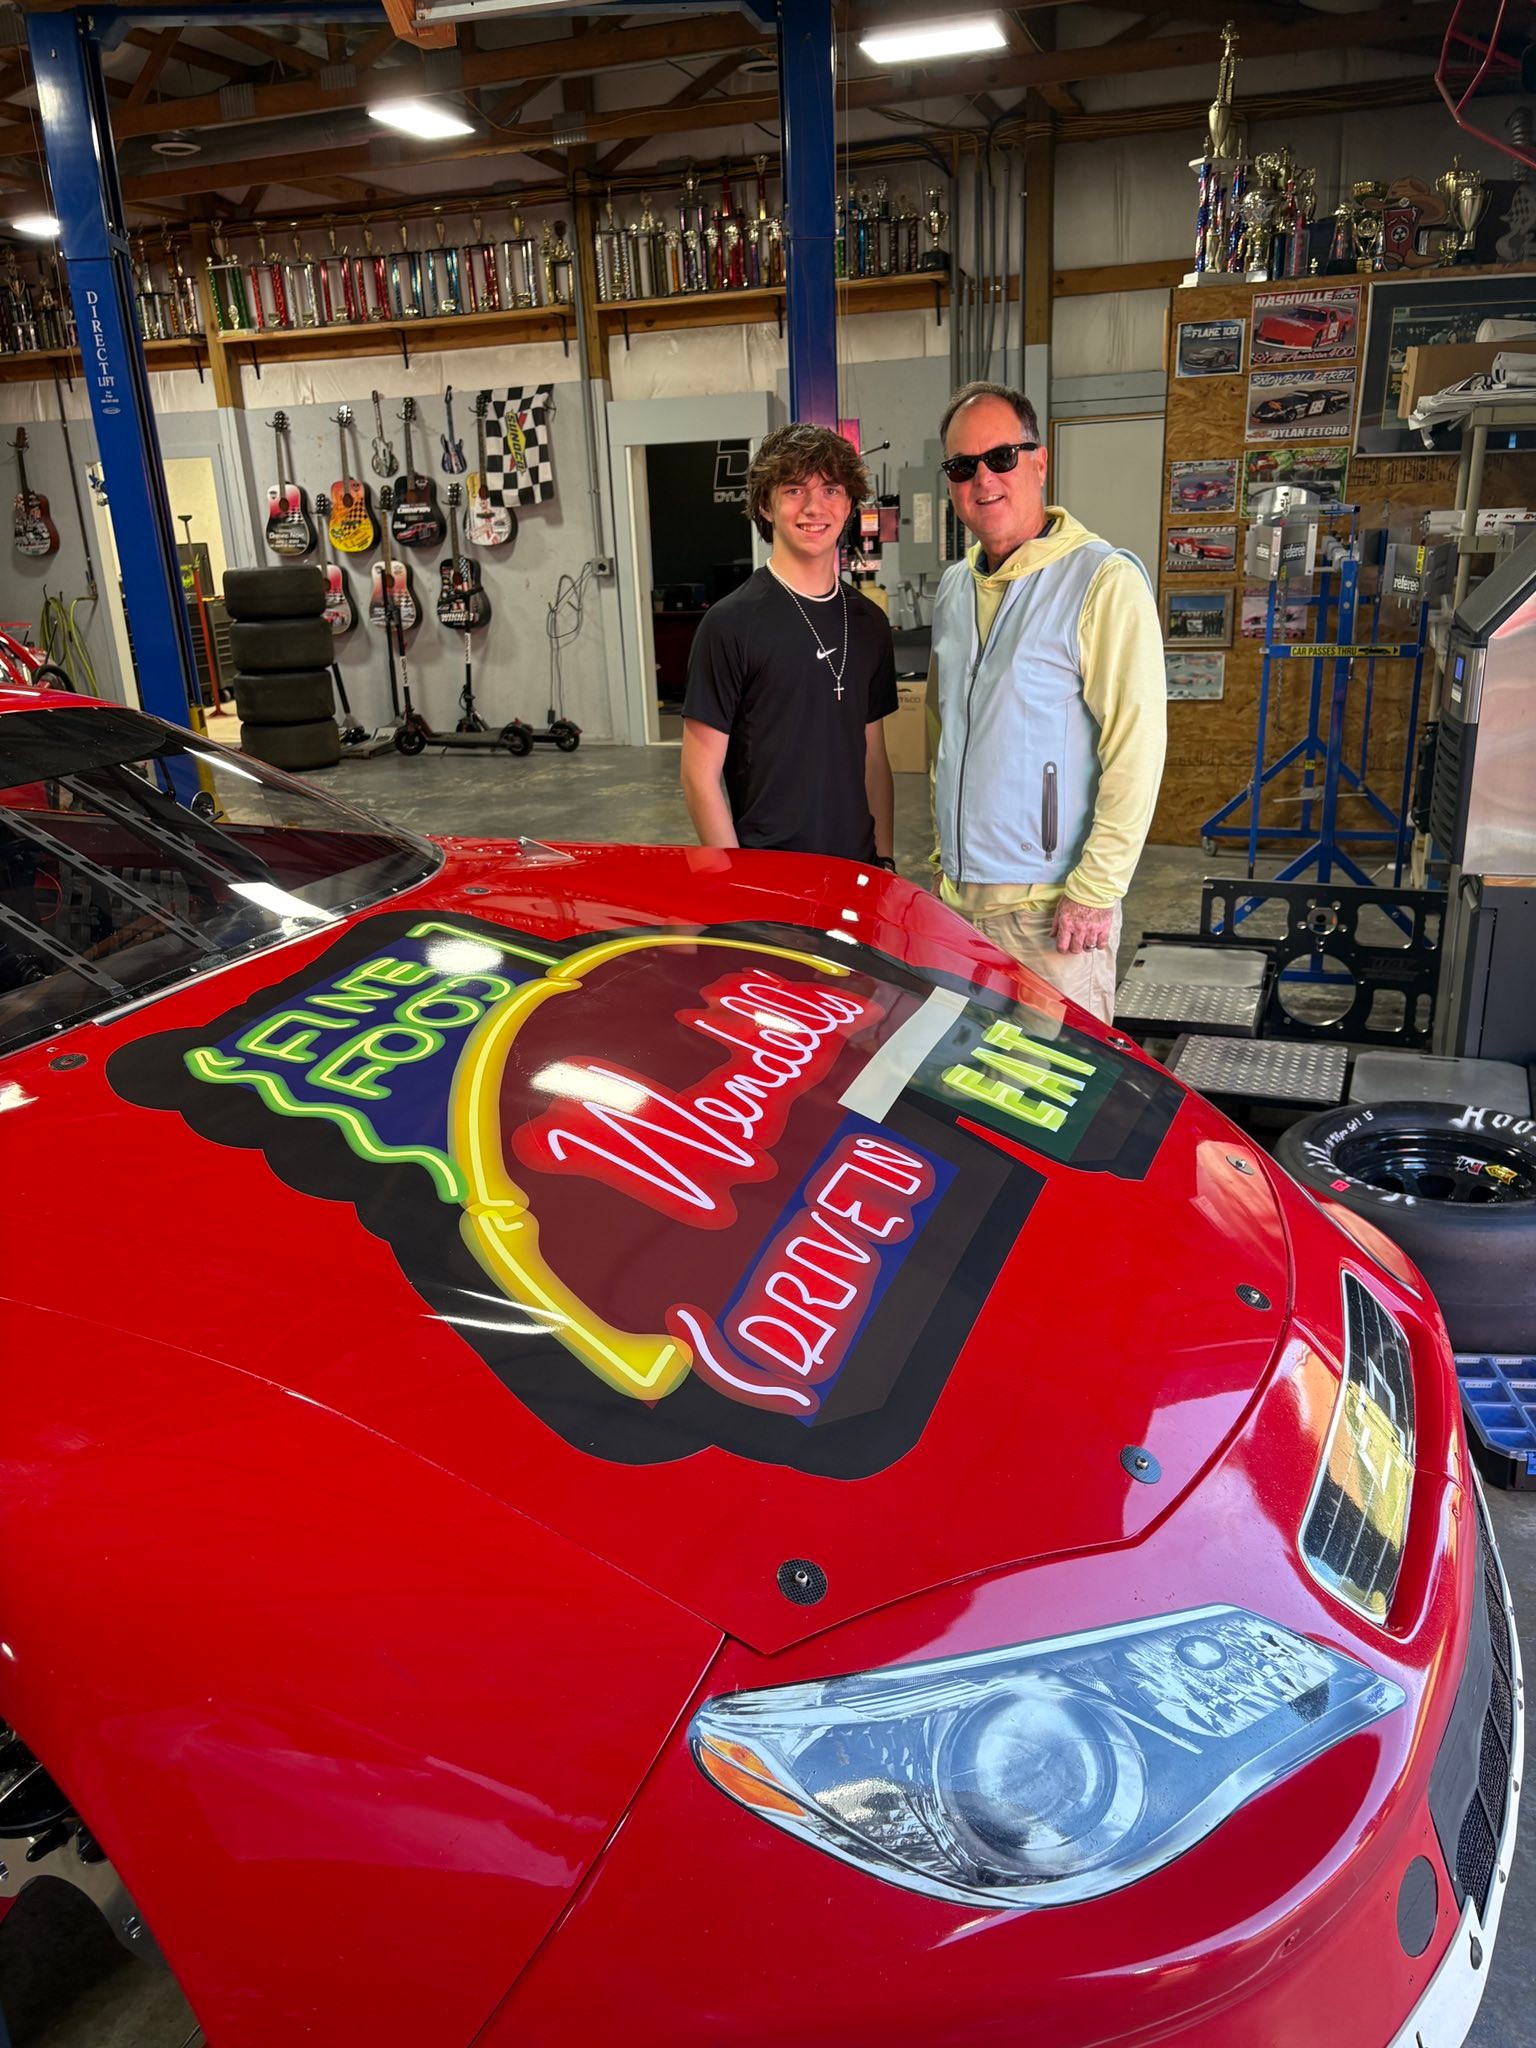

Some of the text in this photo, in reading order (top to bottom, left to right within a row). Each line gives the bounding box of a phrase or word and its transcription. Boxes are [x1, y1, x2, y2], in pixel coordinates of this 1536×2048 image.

[1255, 291, 1333, 308] NASHVILLE
[86, 290, 109, 375] DIRECT
[1222, 326, 1240, 336] 100
[1328, 346, 1354, 357] 400
[98, 376, 115, 387] LIFT
[1251, 373, 1311, 387] SNOWBALL
[1313, 369, 1355, 381] DERBY
[1271, 426, 1348, 438] DYLAN FETCHO
[1393, 575, 1420, 592] referee
[1292, 645, 1358, 656] CAR PASSES THRU
[942, 1018, 1098, 1133] EAT
[737, 1137, 924, 1377] DRIVEN
